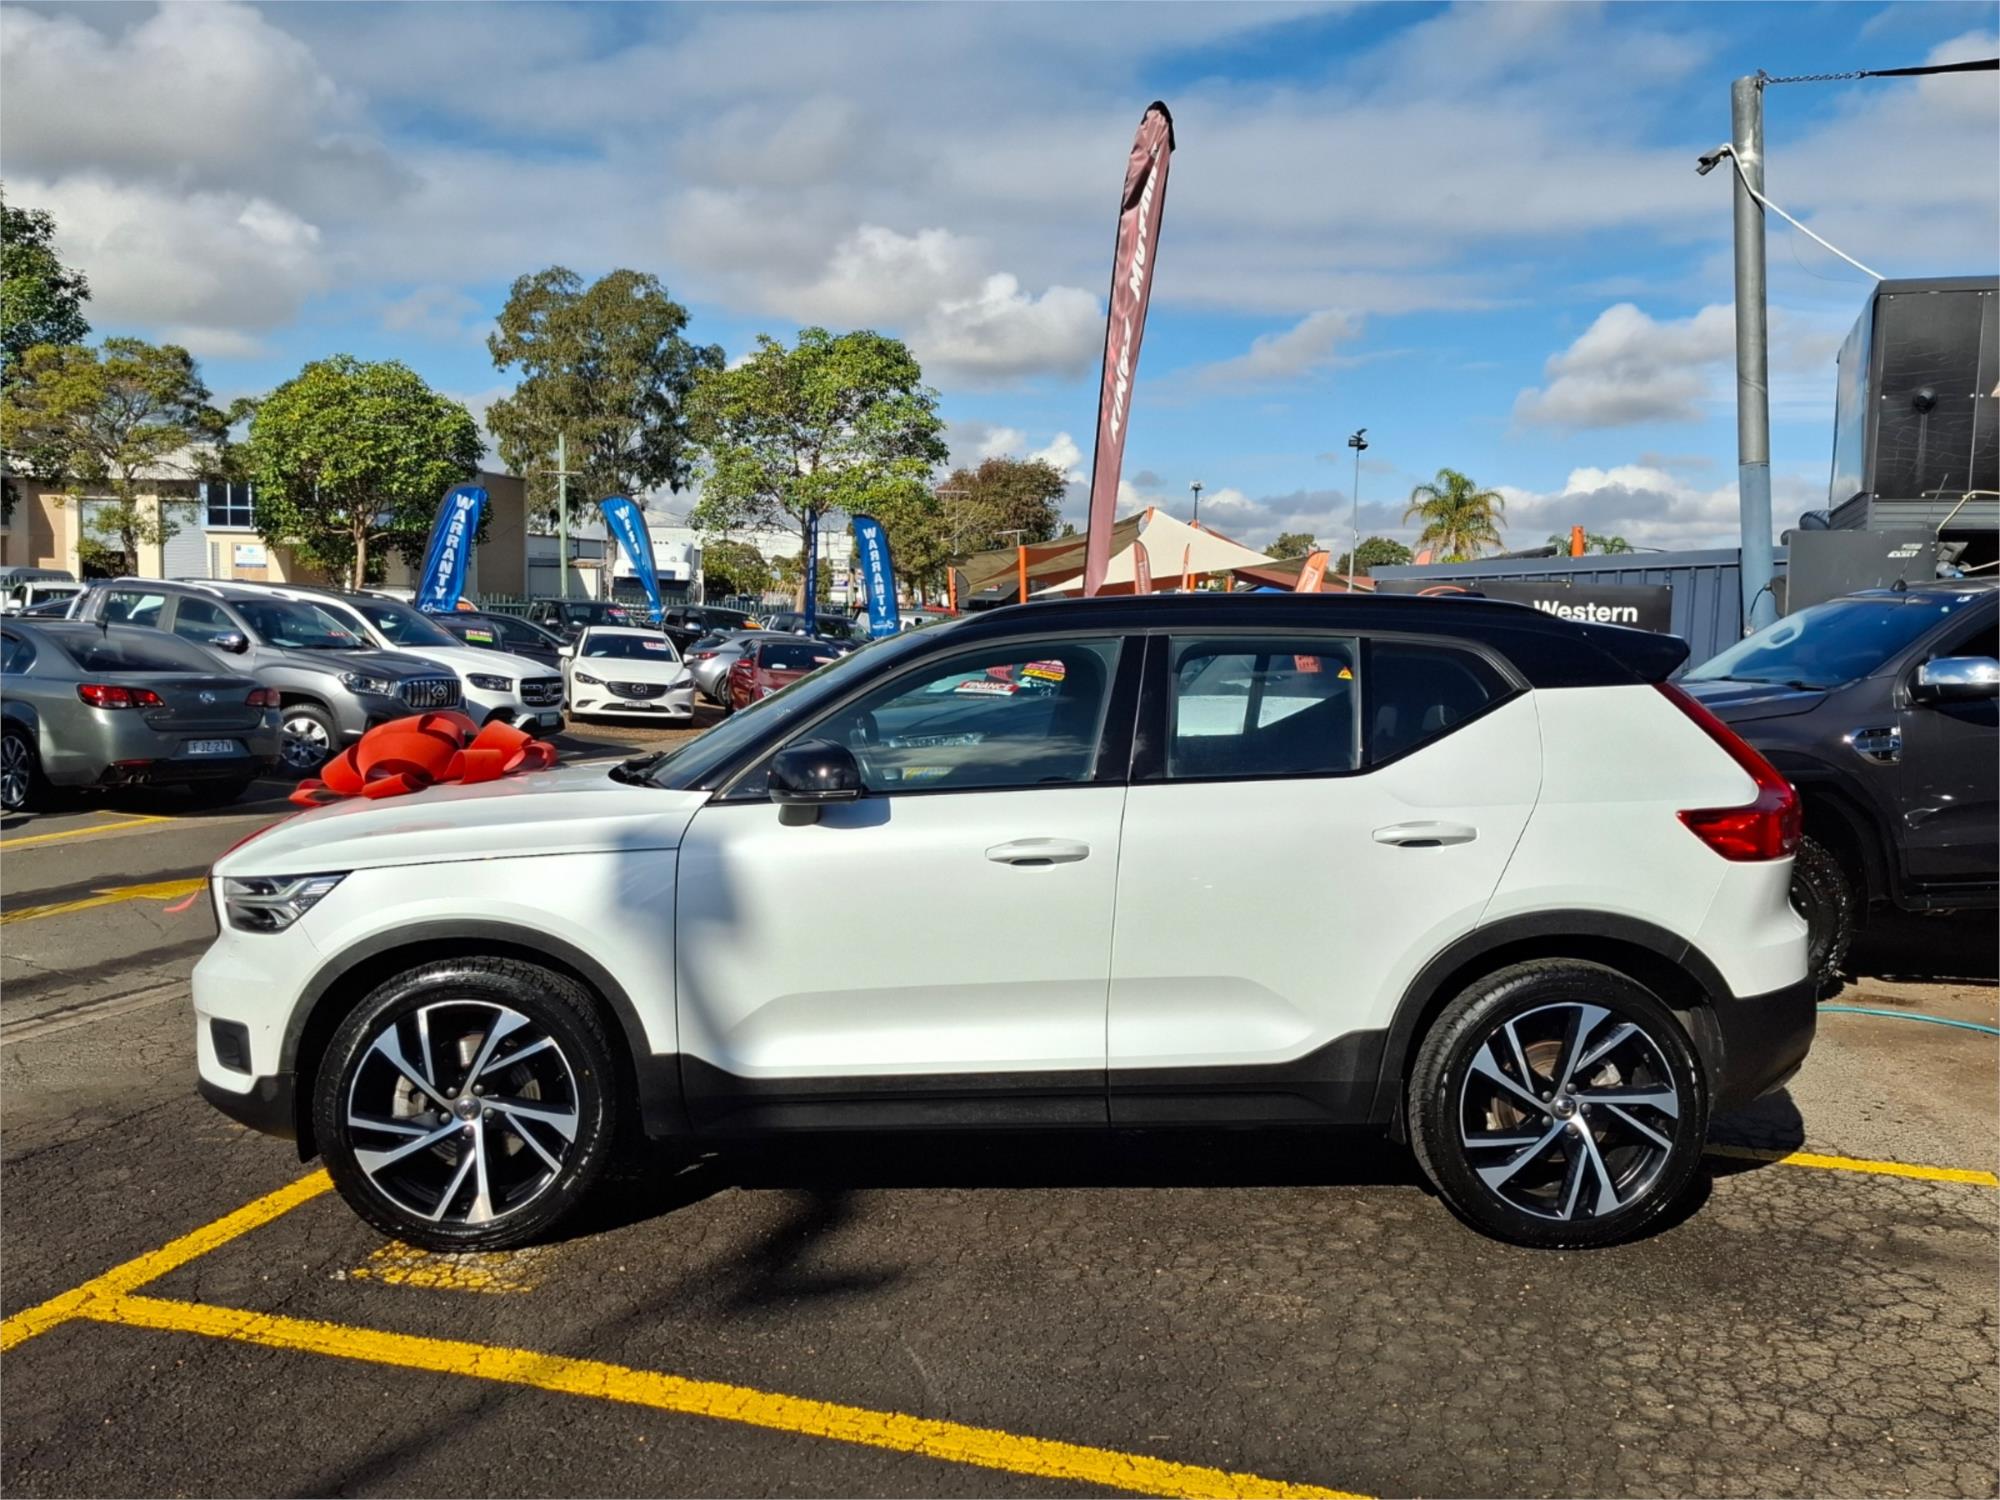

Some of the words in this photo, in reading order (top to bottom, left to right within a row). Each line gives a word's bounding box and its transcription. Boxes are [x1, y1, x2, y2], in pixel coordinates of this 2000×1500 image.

[434, 494, 475, 600] WARRANTY
[1533, 600, 1638, 623] Western
[963, 680, 1014, 691] FINANCE
